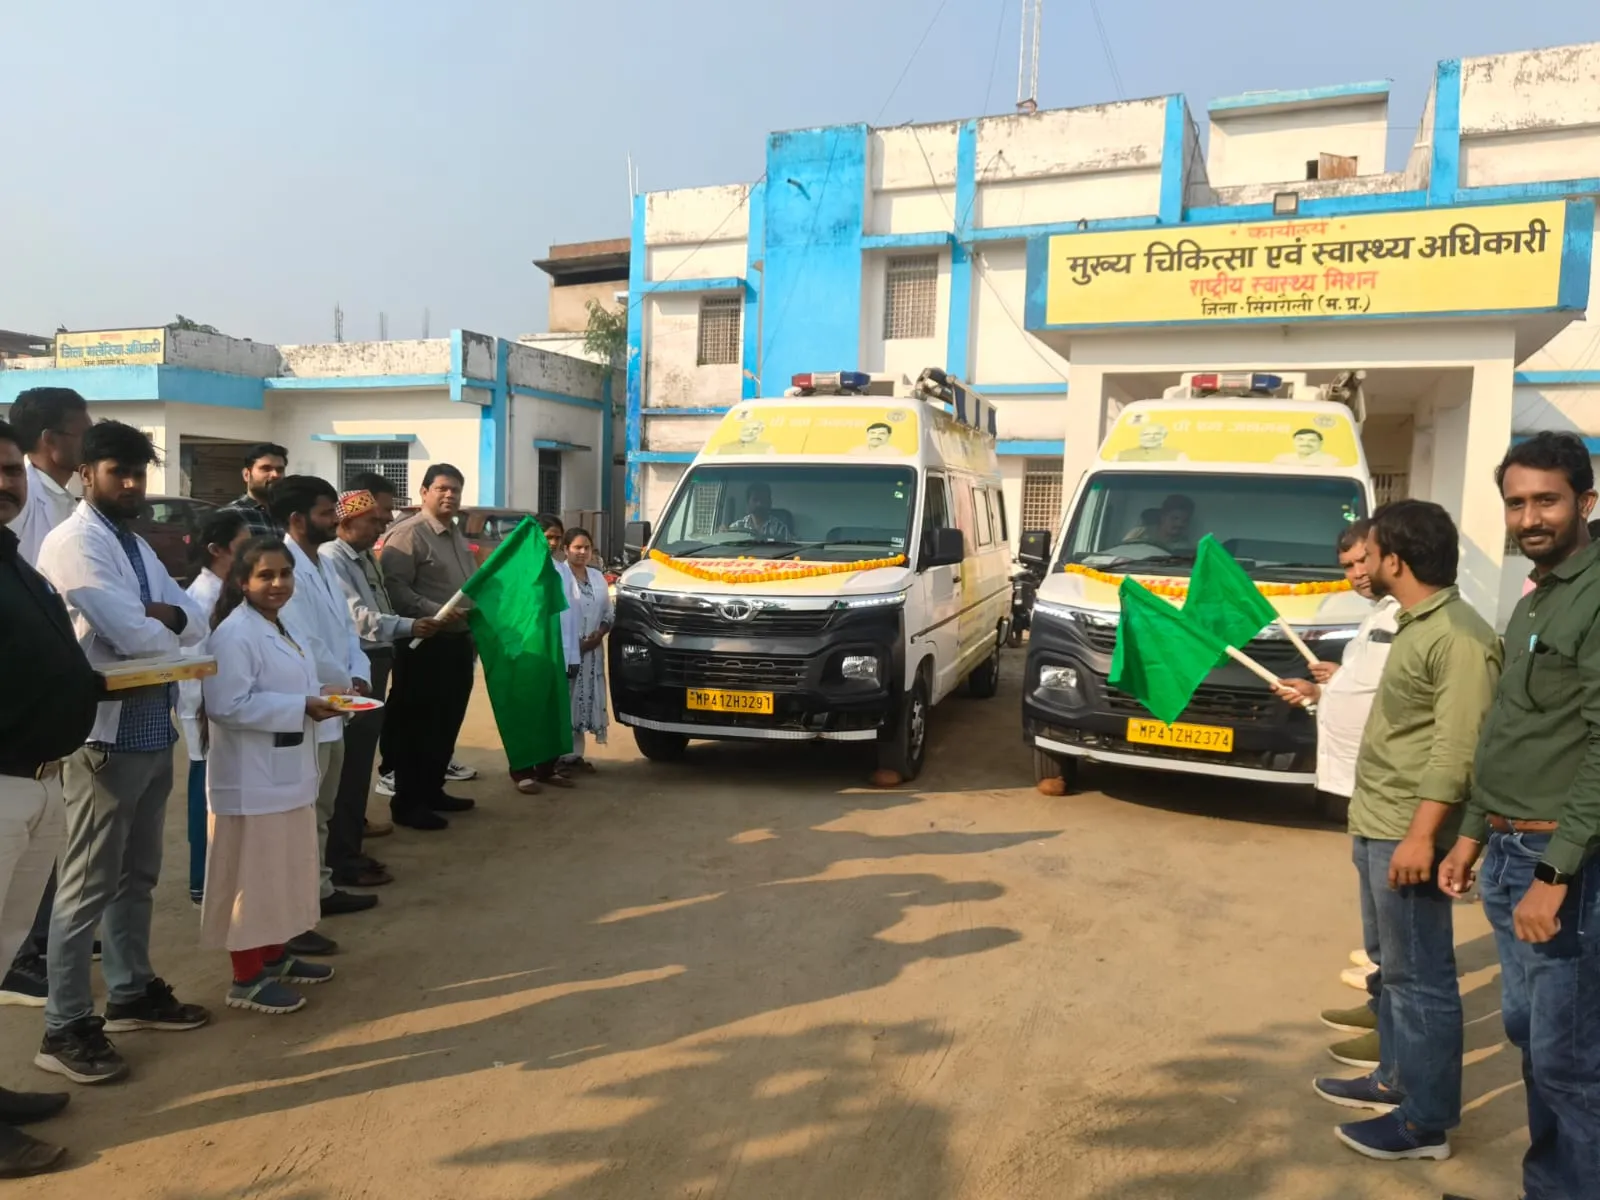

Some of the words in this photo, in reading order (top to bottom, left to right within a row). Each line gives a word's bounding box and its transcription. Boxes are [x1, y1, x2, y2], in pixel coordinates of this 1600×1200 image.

[1066, 253, 1136, 285] मुख्य
[1144, 239, 1258, 272] चिकित्सा
[1265, 237, 1307, 268] एवं
[1312, 236, 1415, 265] स्वास्थ्य
[1418, 218, 1551, 258] अधिकारी
[1189, 270, 1246, 300] राष्ट्रीय
[1251, 273, 1318, 296] स्वास्थ्य
[1323, 267, 1379, 292] मिशन
[696, 691, 771, 709] MP41ZH3291
[1139, 722, 1230, 746] MP41ZH2374
